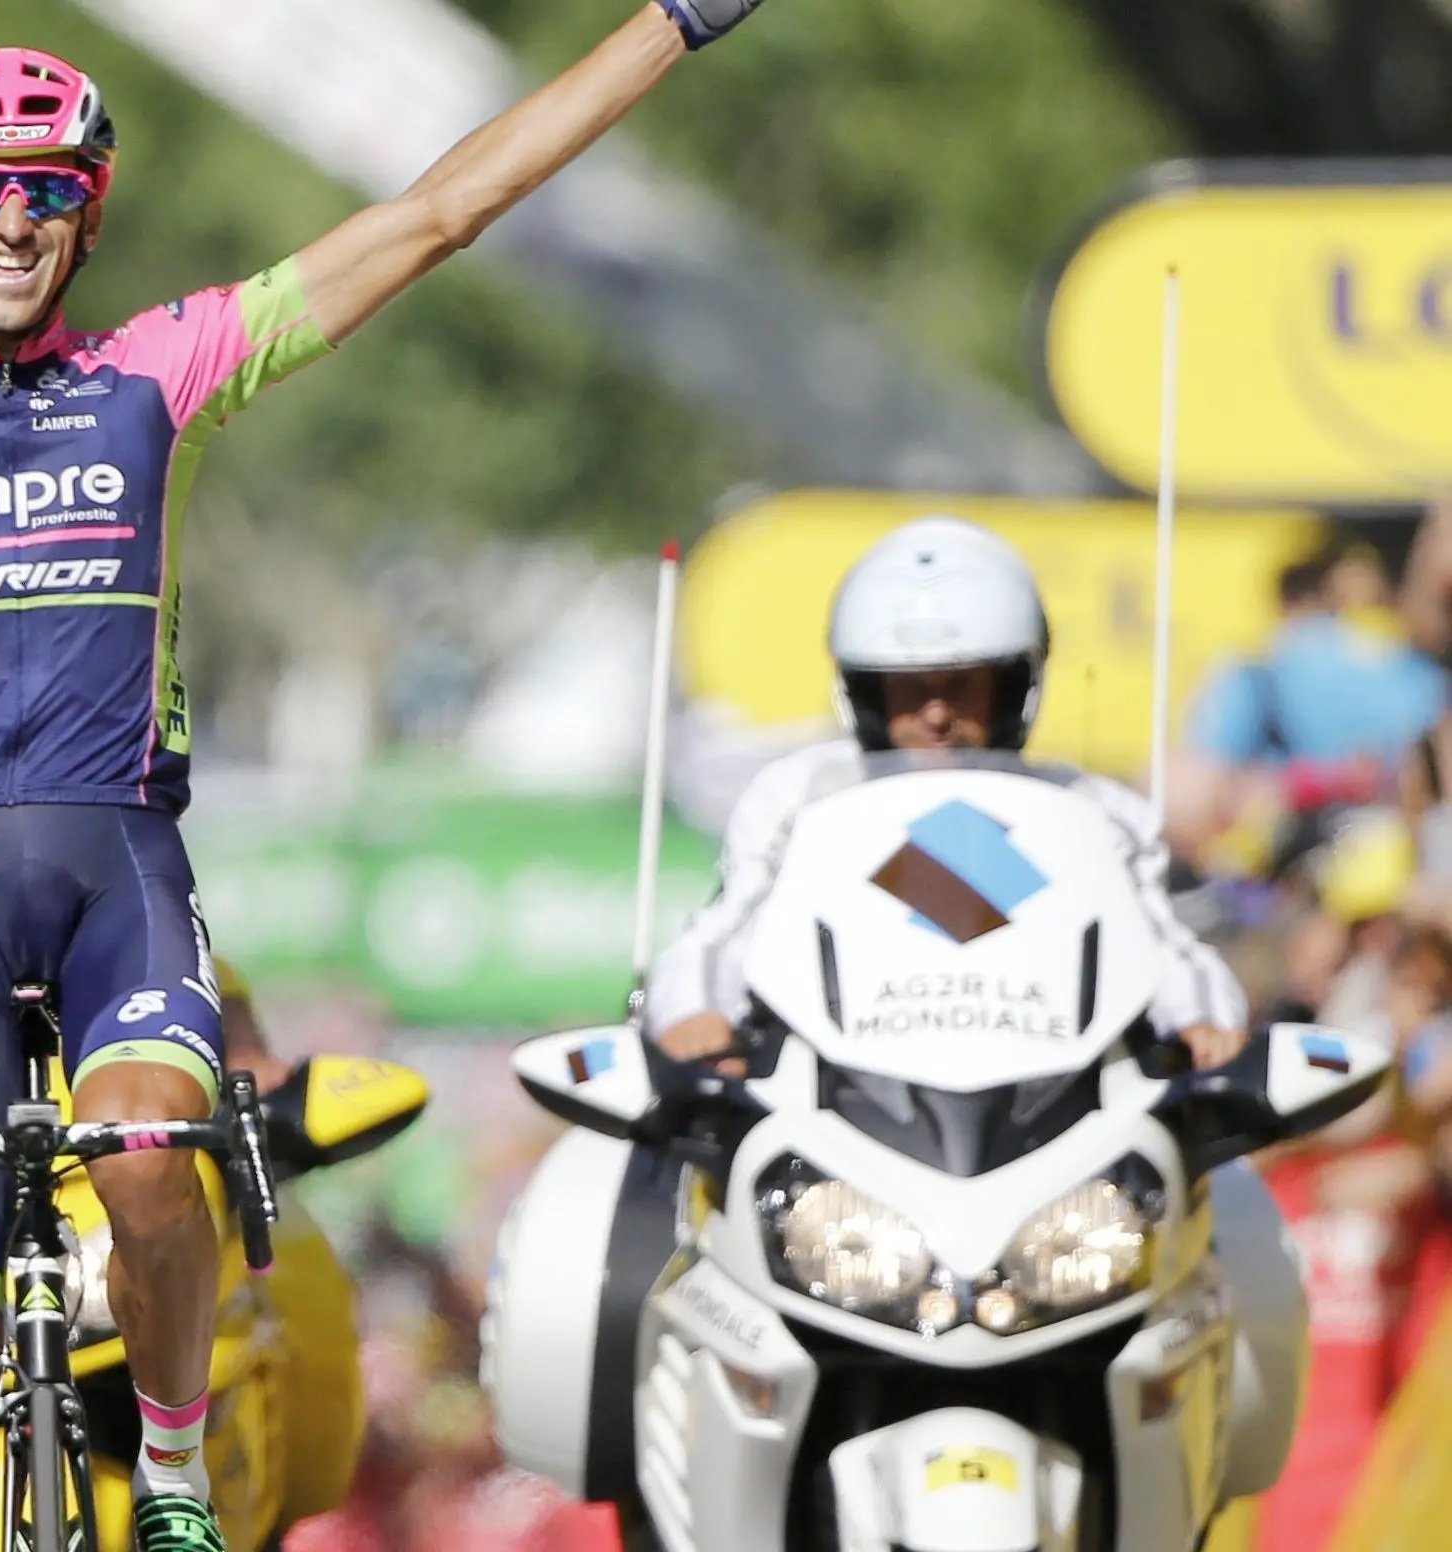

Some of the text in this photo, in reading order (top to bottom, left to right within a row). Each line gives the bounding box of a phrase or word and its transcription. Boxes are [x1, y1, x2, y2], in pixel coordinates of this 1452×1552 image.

[32, 414, 98, 432] LAMFER
[31, 508, 118, 530] prerivestite
[873, 972, 1049, 1004] AG2R LA
[852, 1005, 1069, 1041] MONDIALE
